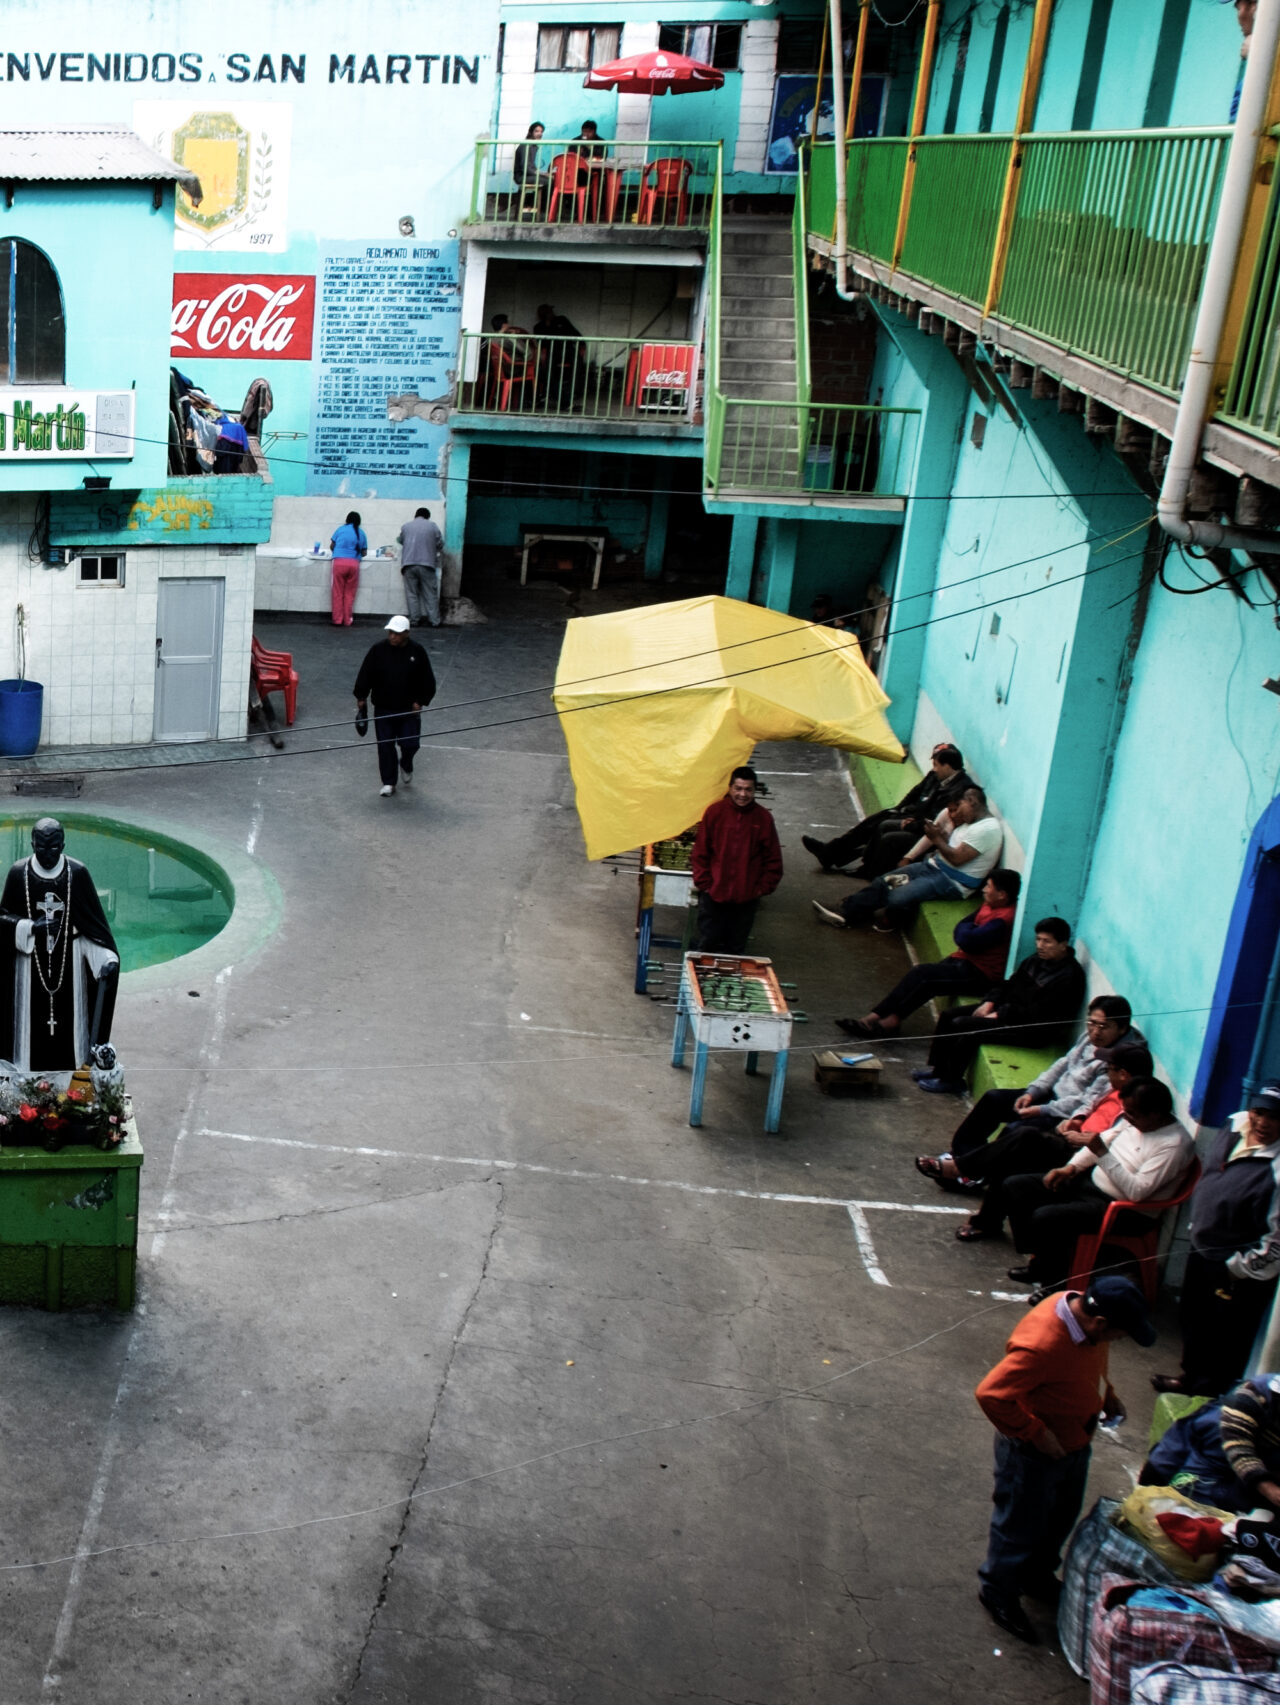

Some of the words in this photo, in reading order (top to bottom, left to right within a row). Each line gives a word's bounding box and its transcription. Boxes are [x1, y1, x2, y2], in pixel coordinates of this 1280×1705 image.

[208, 72, 217, 83] A
[648, 68, 677, 79] Coca-Cola
[249, 232, 273, 245] 1997
[366, 247, 408, 258] REGLAMENTO
[412, 247, 440, 259] INTERNO
[171, 283, 305, 352] a-Cola
[12, 399, 86, 452] Martín
